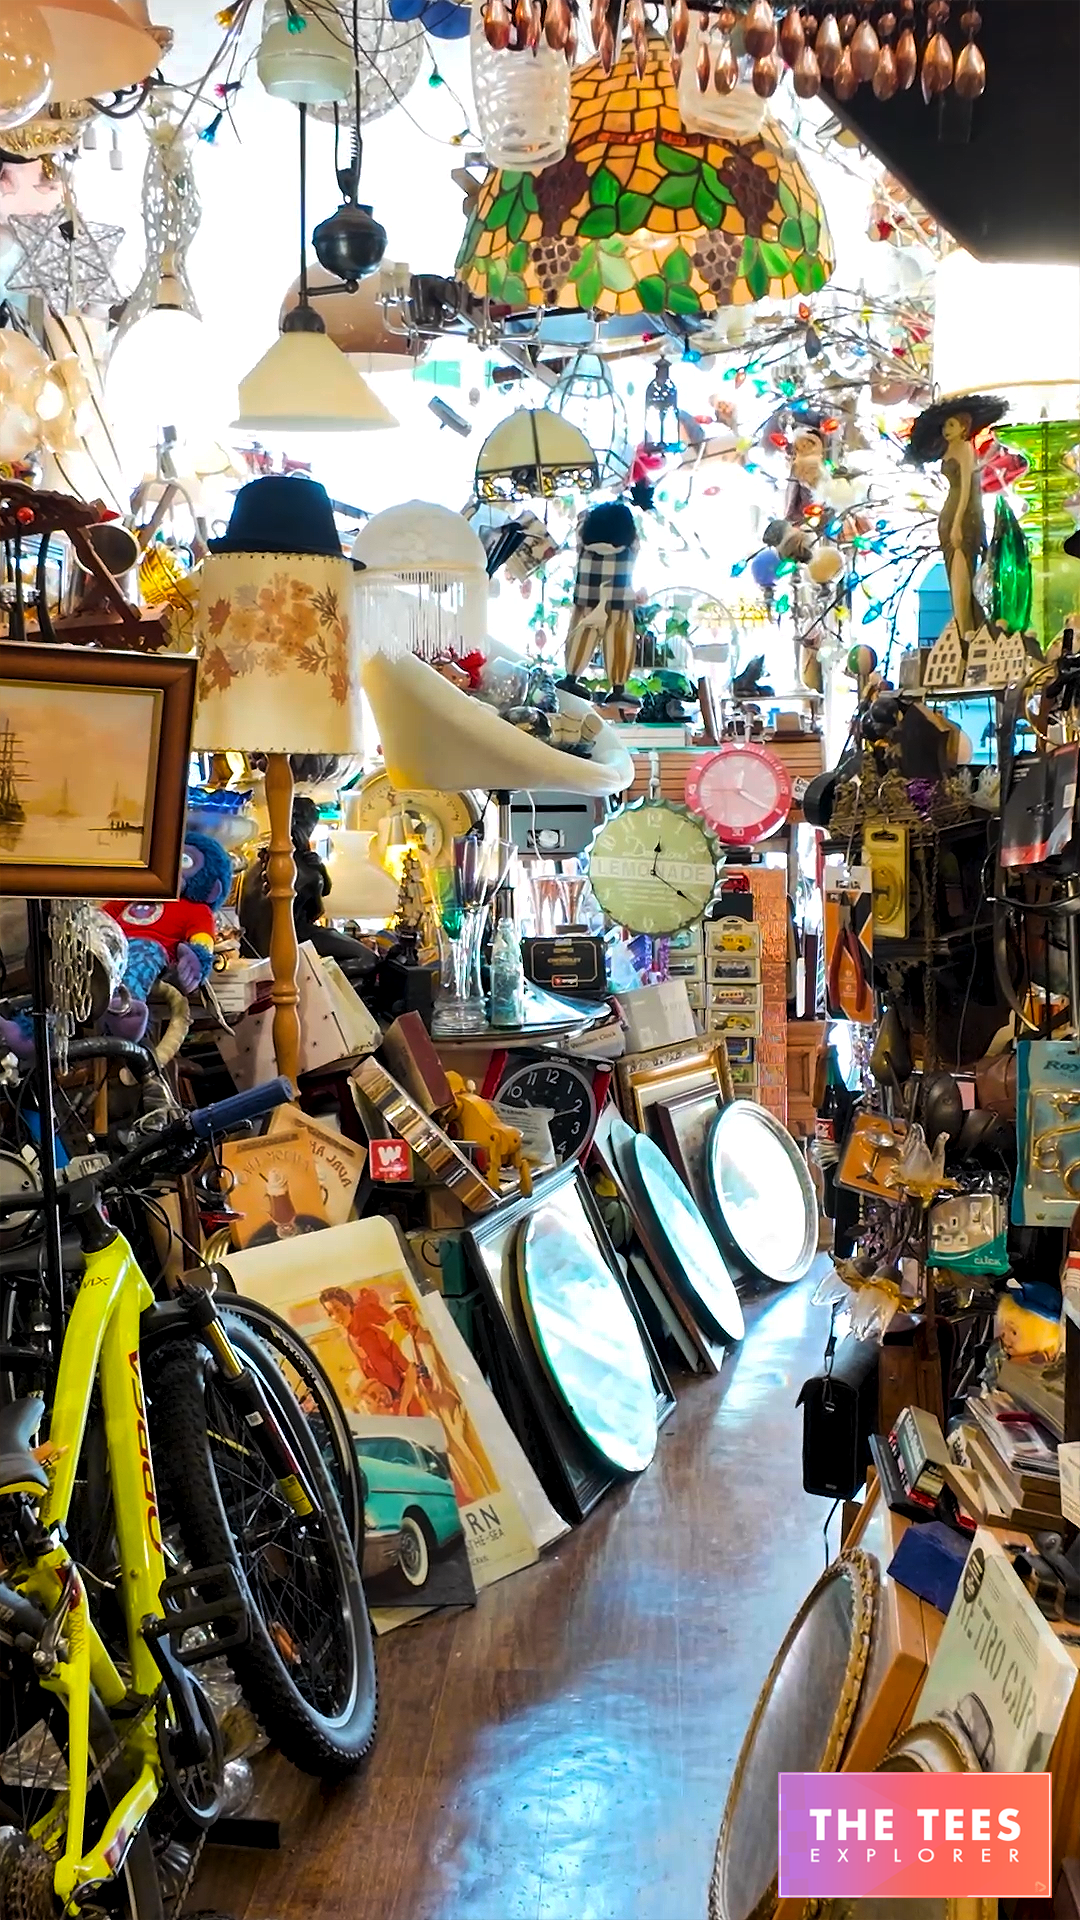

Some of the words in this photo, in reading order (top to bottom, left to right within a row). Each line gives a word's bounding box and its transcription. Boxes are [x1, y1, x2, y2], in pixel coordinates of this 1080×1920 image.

[526, 1070, 539, 1087] 11
[545, 1068, 560, 1085] 12
[506, 1084, 523, 1099] 10
[566, 1080, 575, 1095] 1
[571, 1098, 584, 1114] 2
[570, 1120, 581, 1136] 3
[556, 1139, 568, 1154] 4
[326, 1154, 353, 1188] JAVA
